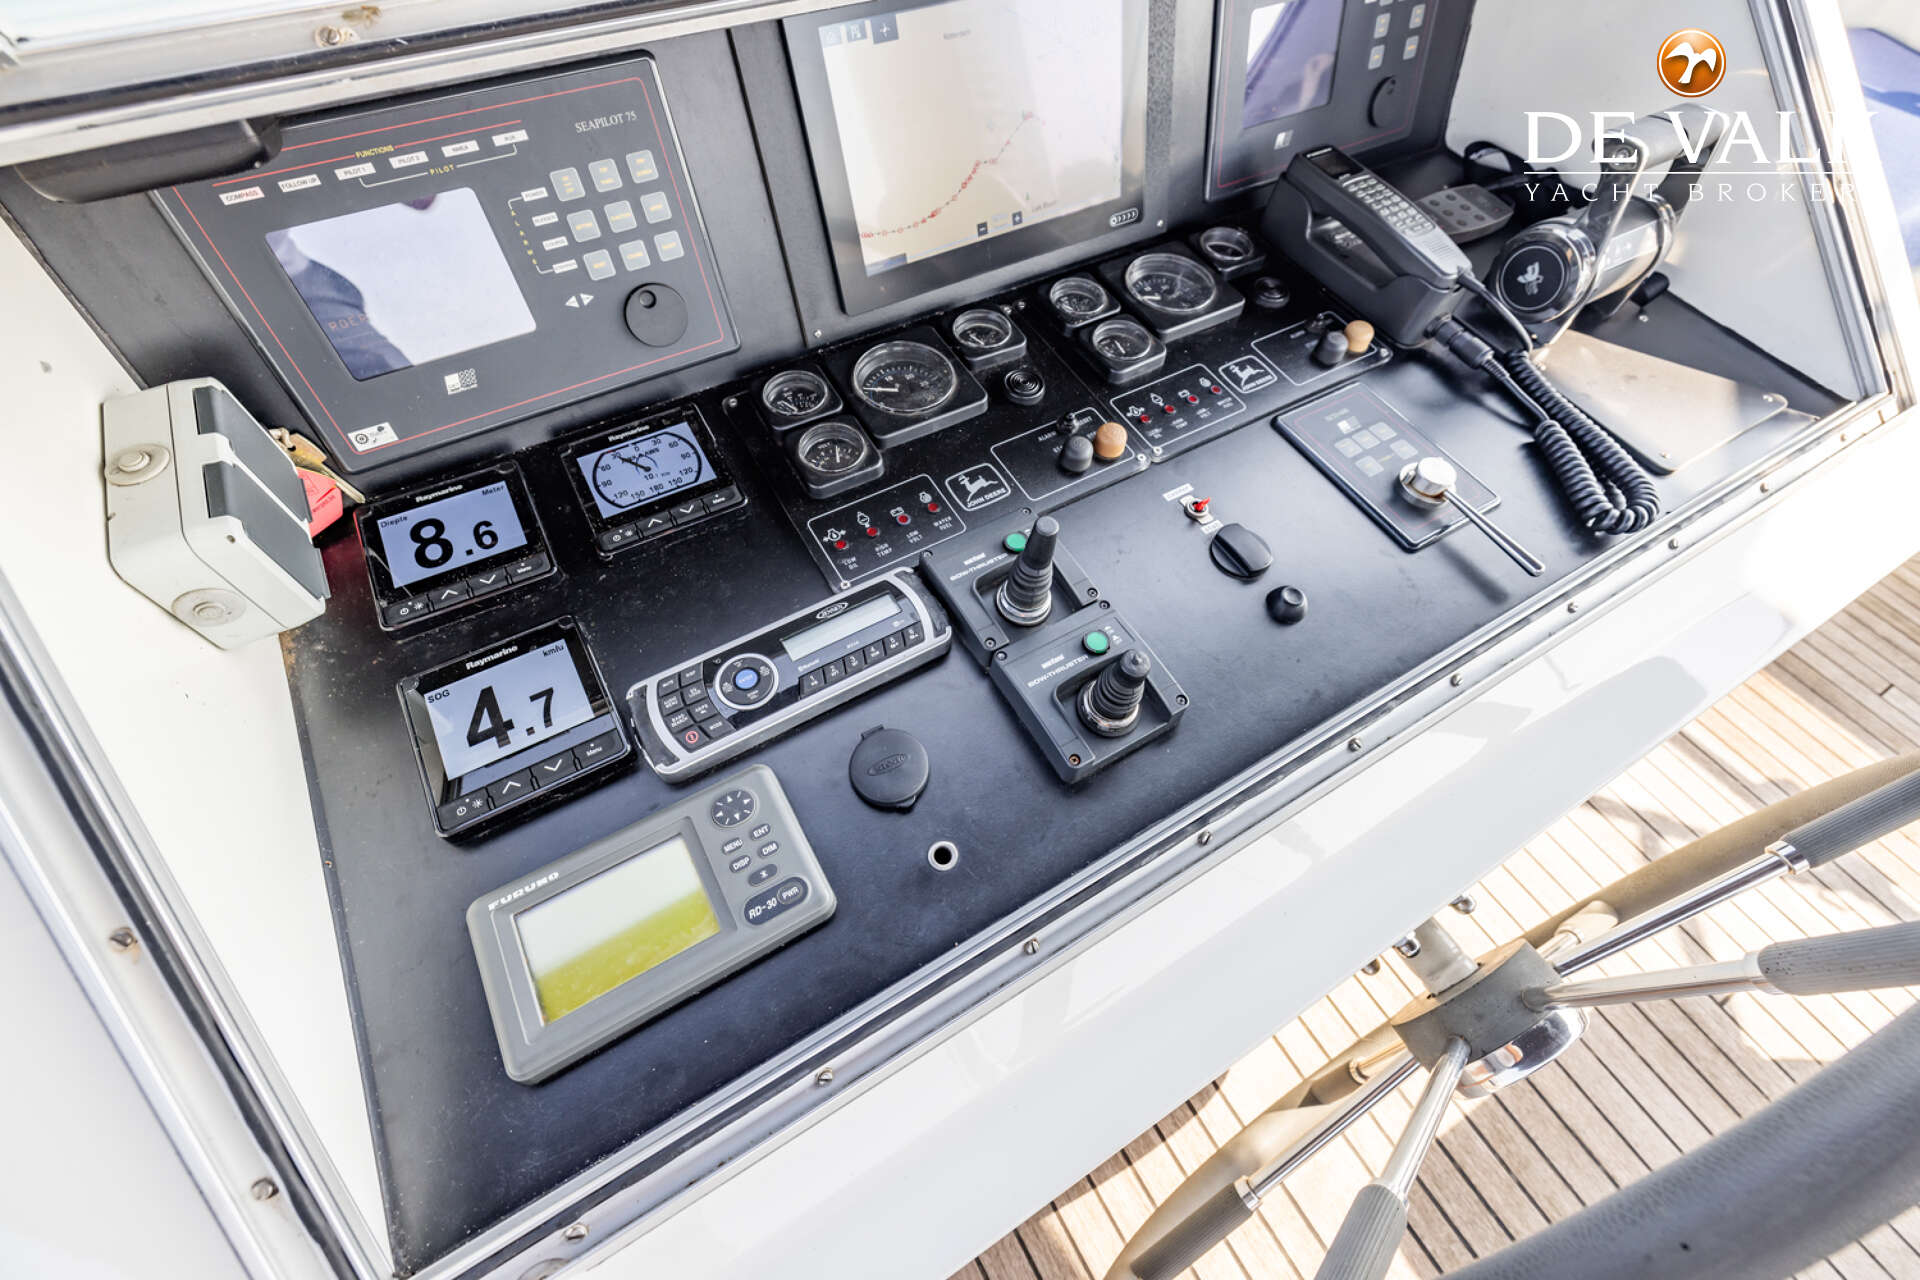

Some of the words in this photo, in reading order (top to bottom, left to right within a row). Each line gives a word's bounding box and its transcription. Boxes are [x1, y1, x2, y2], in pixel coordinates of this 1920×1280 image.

[575, 114, 624, 133] SEAPILOT
[625, 110, 637, 122] 75
[355, 144, 394, 159] FUNCTIONS
[429, 164, 455, 175] PILOT
[226, 190, 259, 201] COMPASS
[679, 466, 694, 476] 120
[415, 484, 463, 503] Raymarine
[482, 485, 505, 497] Meter
[380, 515, 408, 529] Diepte
[410, 518, 499, 569] 8.6
[465, 645, 518, 670] Raymarine
[428, 689, 450, 704] SOG
[466, 685, 554, 748] 4.7
[753, 824, 769, 838] ENT
[723, 839, 743, 852] MENU
[762, 842, 778, 855] DIM
[732, 856, 750, 870] DISP
[488, 872, 559, 911] FURUNO
[782, 886, 799, 900] PWR
[748, 897, 777, 919] RD-30
